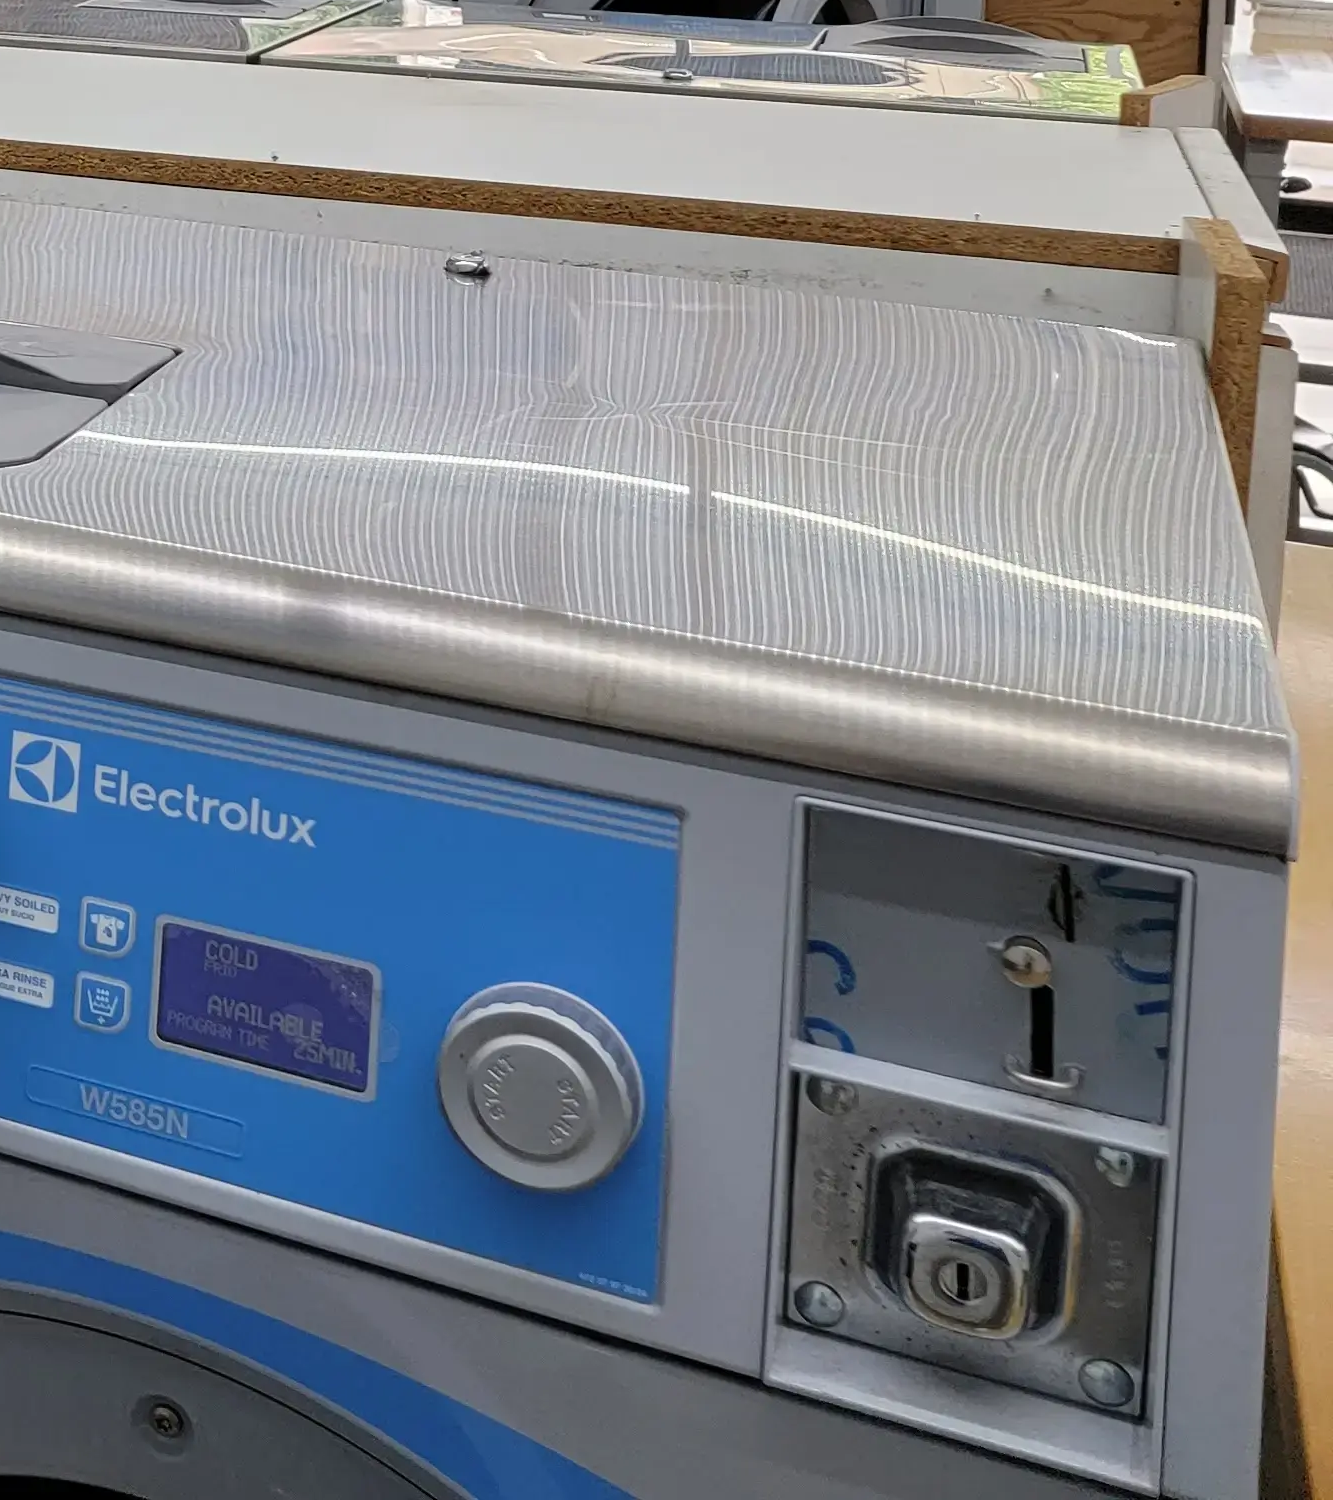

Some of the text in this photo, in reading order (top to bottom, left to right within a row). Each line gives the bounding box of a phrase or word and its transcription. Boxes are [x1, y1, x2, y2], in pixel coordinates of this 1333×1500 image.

[94, 764, 317, 848] Electrolux
[11, 909, 35, 921] SUCIO
[14, 895, 57, 915] SOILED
[205, 939, 258, 971] COLD
[13, 971, 47, 989] RINSE
[18, 987, 43, 999] EXTRA
[166, 1009, 270, 1050] PROGRAM TIME
[207, 995, 323, 1042] AVAILABLE
[79, 1082, 190, 1139] W585N
